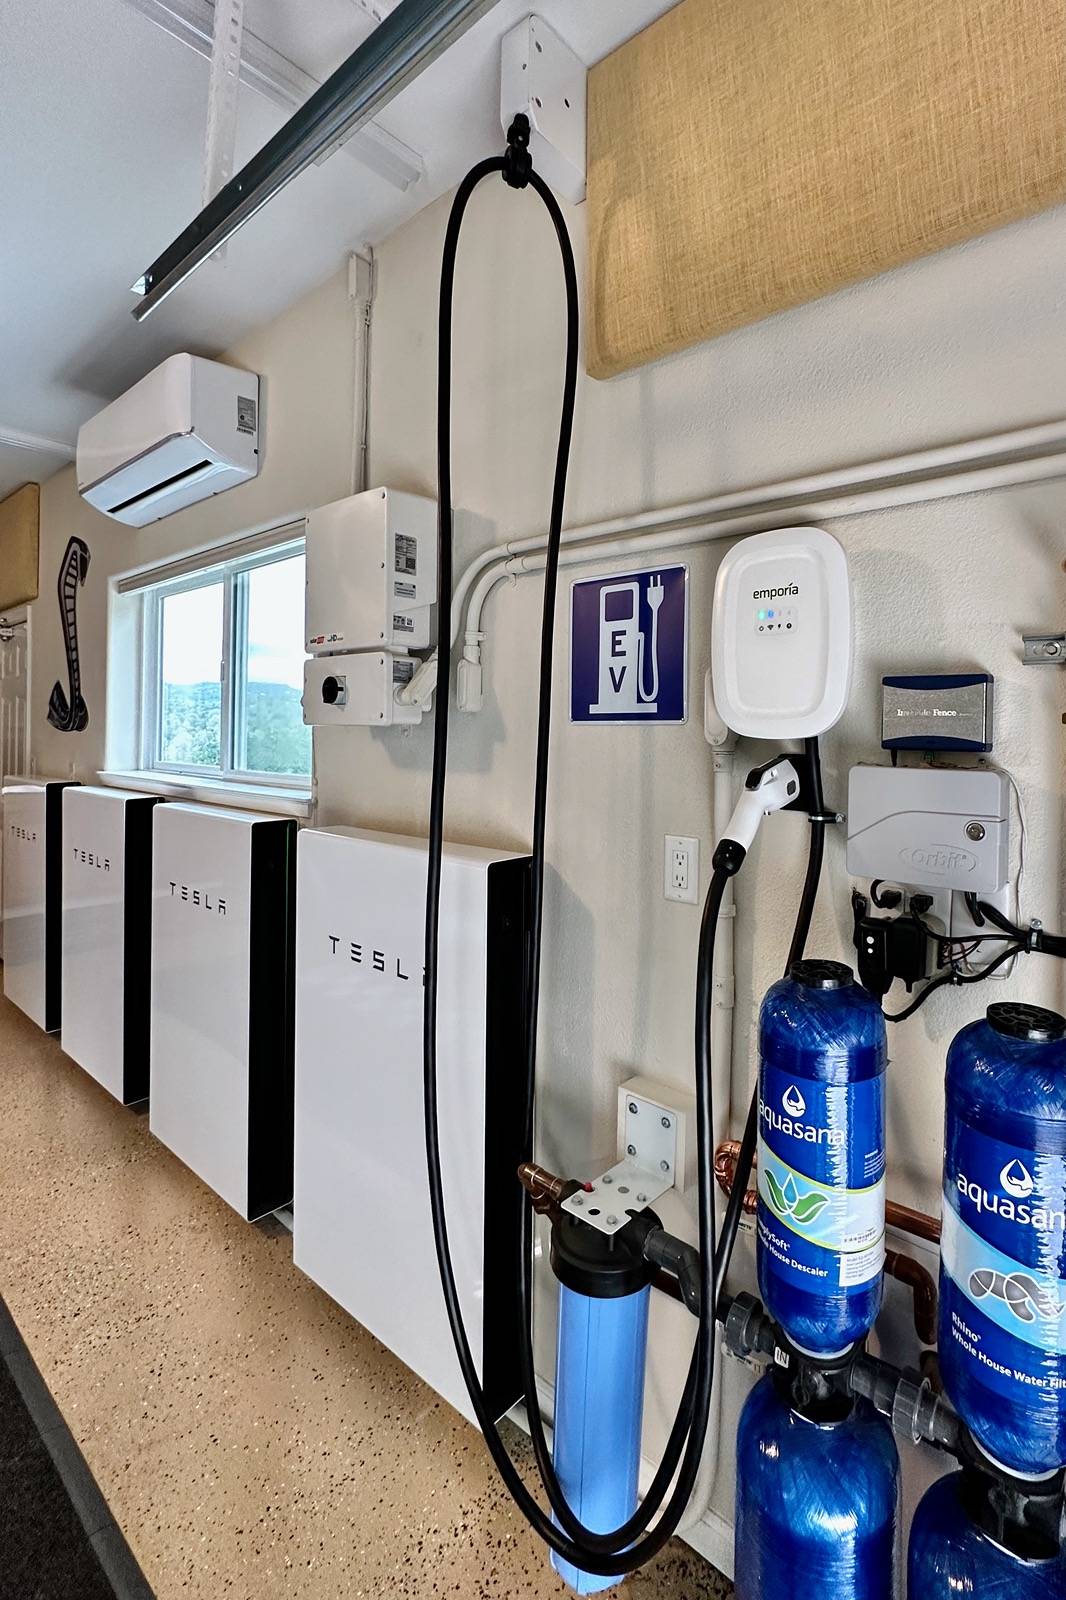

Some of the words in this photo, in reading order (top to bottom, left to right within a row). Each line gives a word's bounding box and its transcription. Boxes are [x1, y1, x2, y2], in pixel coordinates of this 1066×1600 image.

[752, 582, 799, 600] emporía
[933, 708, 957, 717] Fence
[73, 848, 110, 872] TESLA
[169, 881, 226, 915] TESLA
[328, 935, 426, 987] TESL
[760, 1098, 845, 1145] aquasana
[769, 1243, 790, 1265] House
[791, 1259, 828, 1277] Descaler
[952, 1325, 977, 1357] Whole
[978, 1351, 1012, 1377] House
[1013, 1370, 1049, 1388] Water
